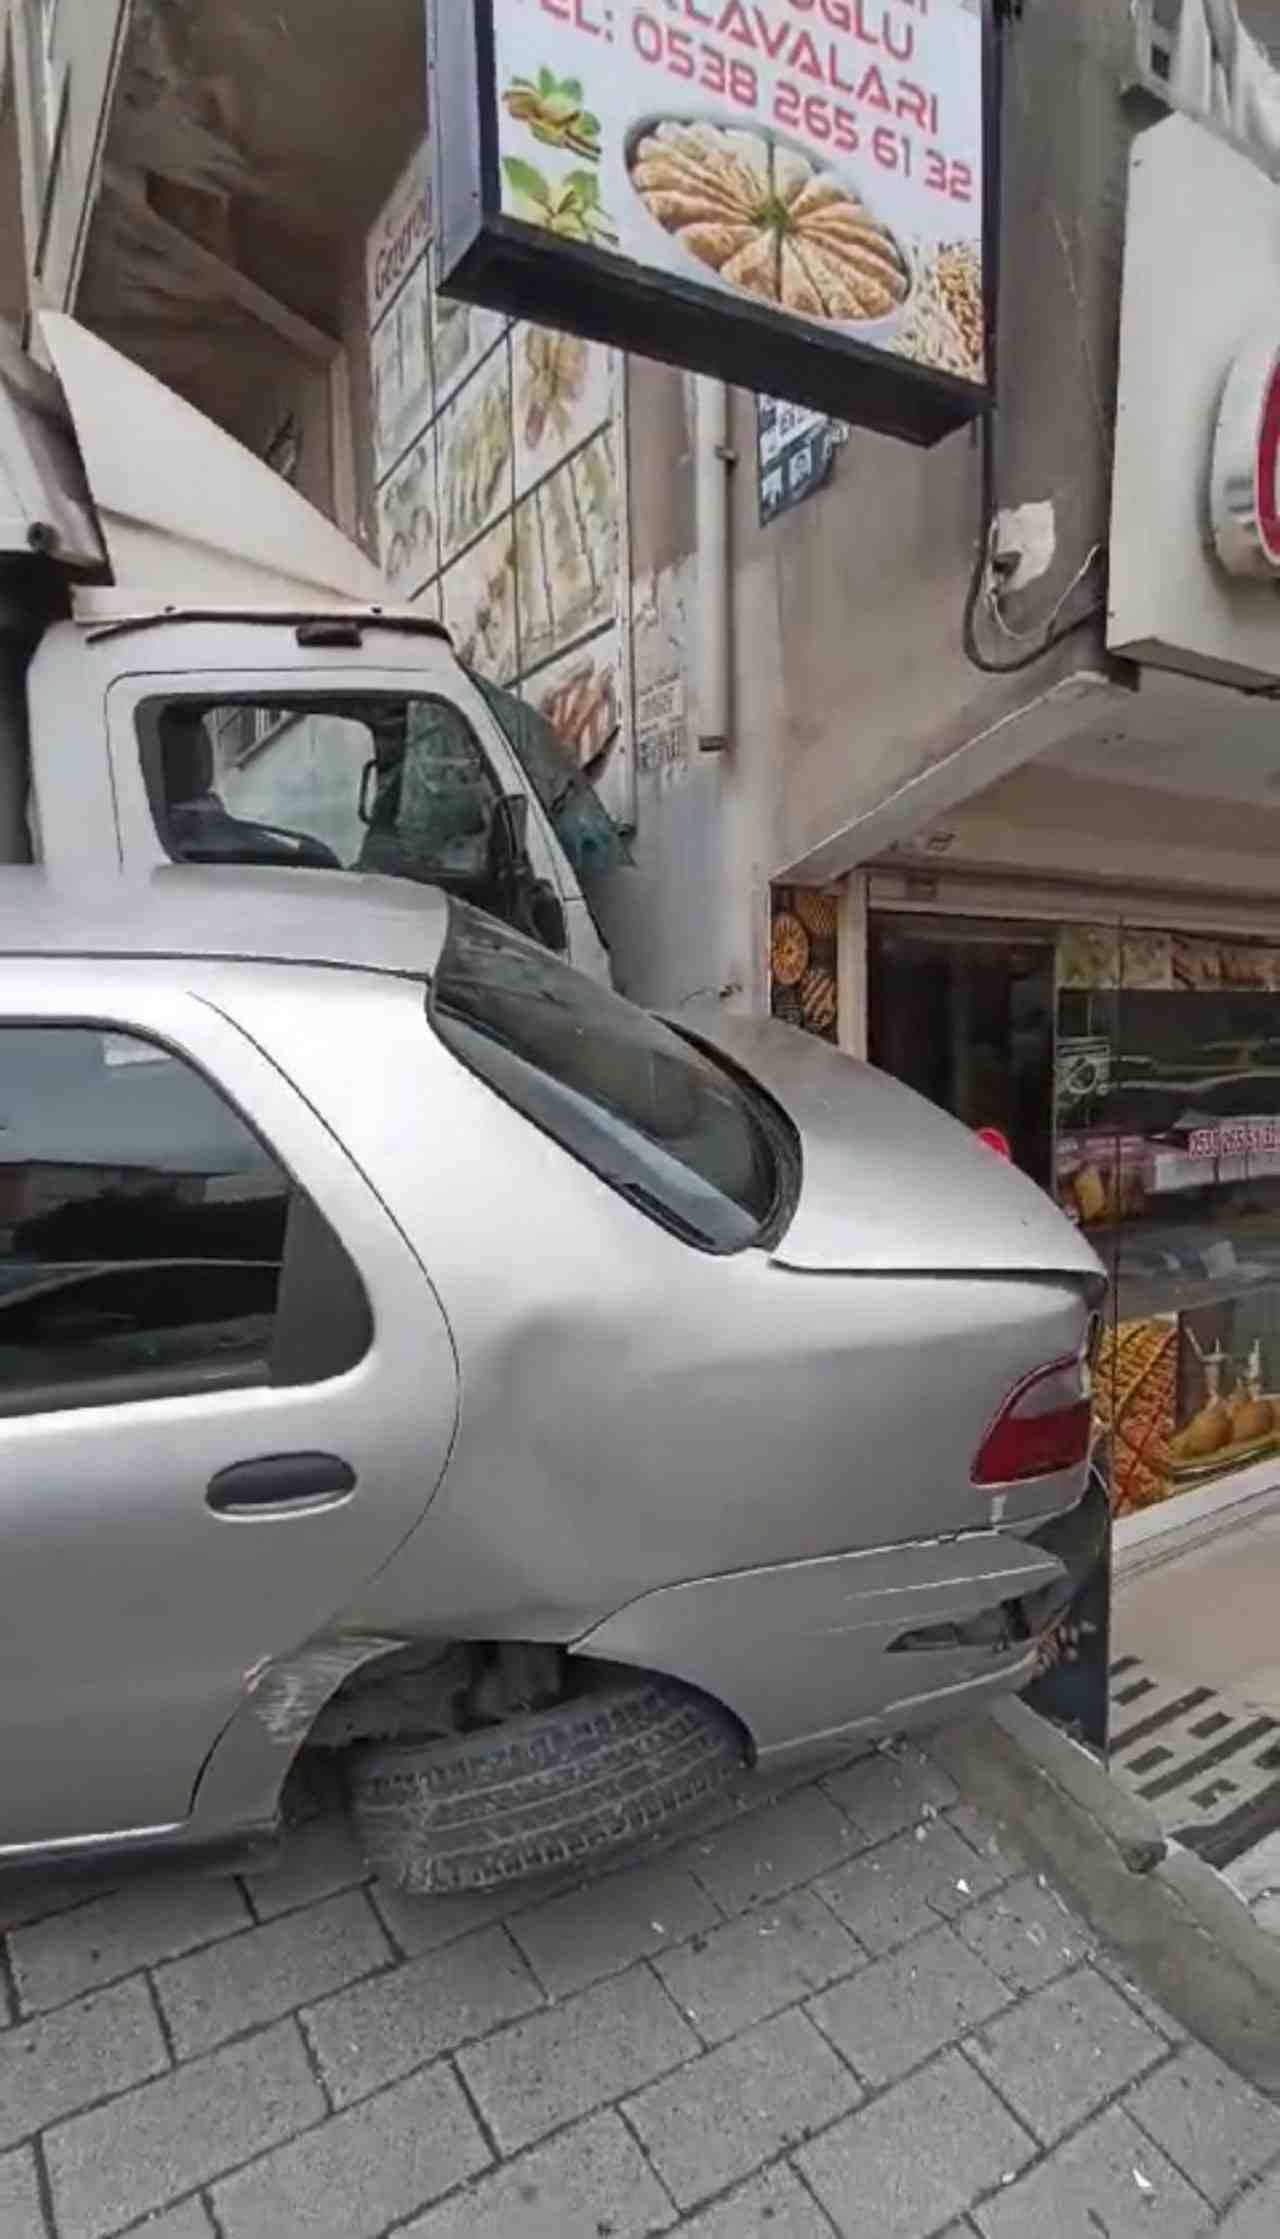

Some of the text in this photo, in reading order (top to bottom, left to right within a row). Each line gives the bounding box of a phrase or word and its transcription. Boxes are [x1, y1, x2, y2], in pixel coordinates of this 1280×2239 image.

[632, 13, 758, 108] 0538
[774, 80, 859, 151] 265
[872, 125, 911, 178] 61
[924, 148, 972, 203] 32
[668, 0, 937, 134] LAVALARI
